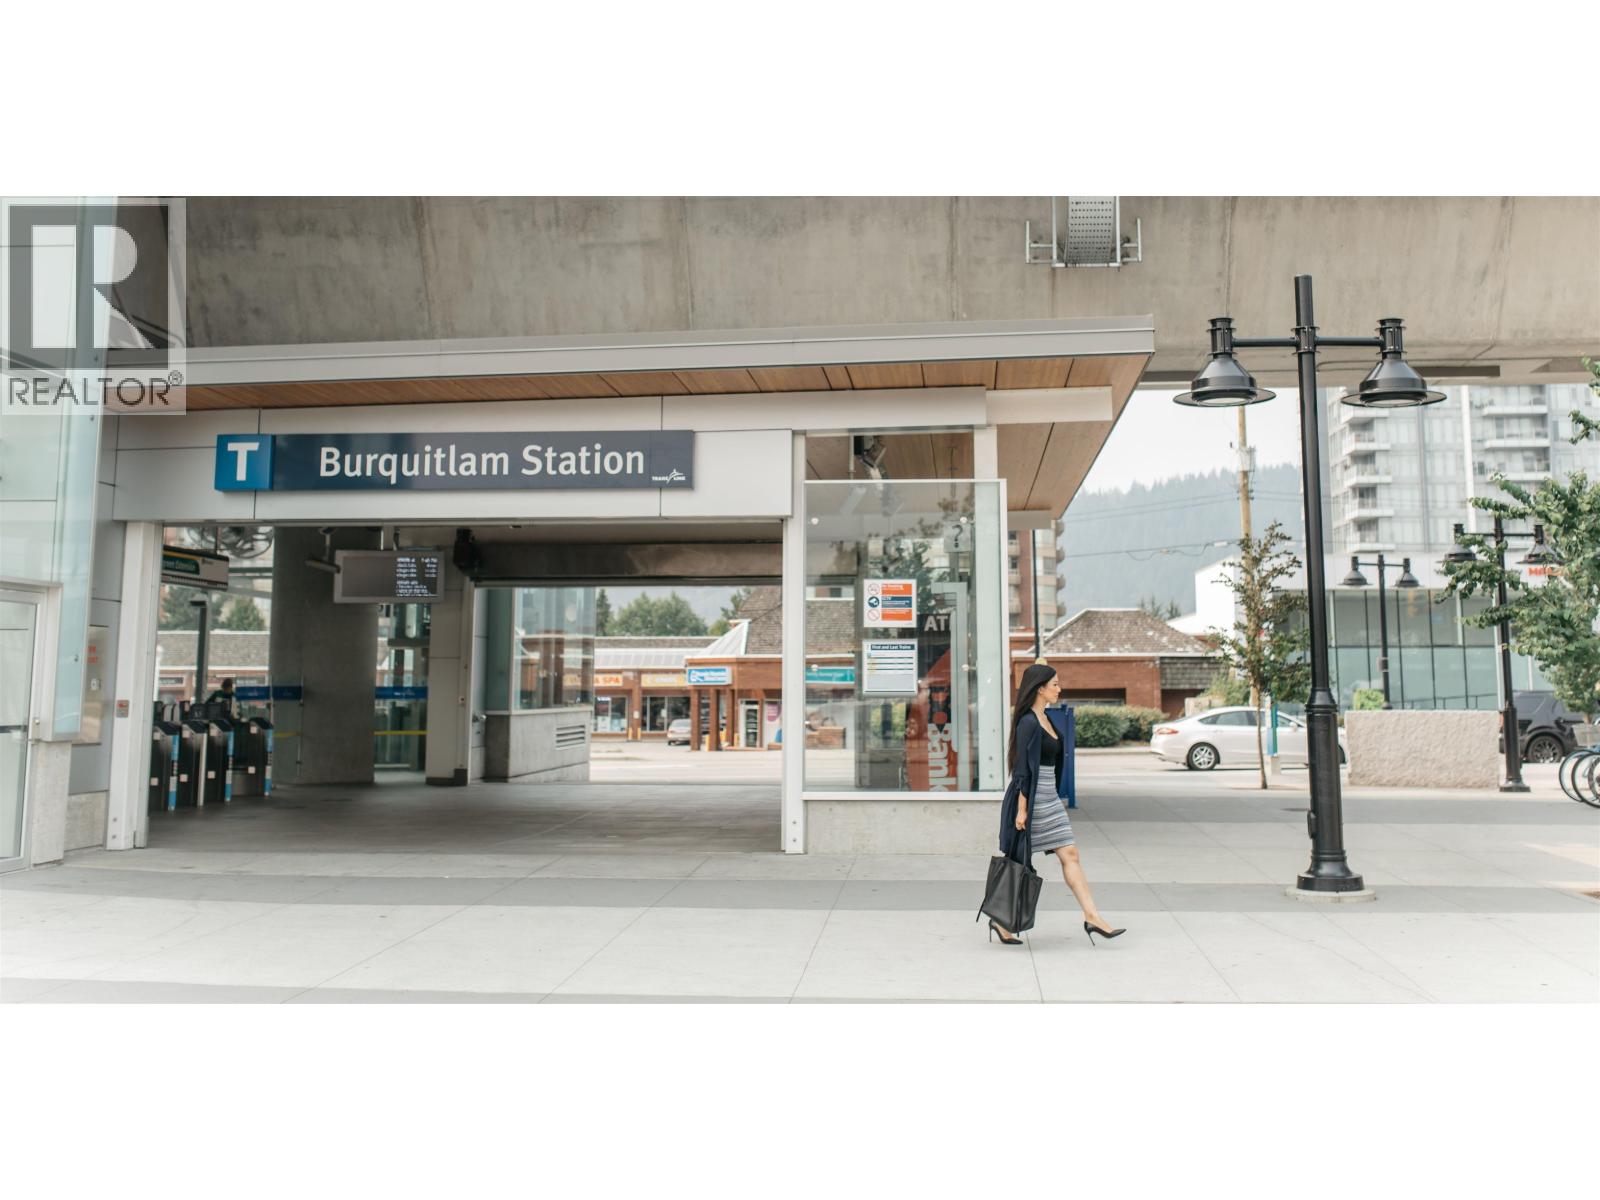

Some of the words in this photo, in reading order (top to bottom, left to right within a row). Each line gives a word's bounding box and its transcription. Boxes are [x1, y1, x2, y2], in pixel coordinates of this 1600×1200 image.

[227, 442, 260, 481] T
[319, 444, 509, 485] Burquitlam
[521, 443, 644, 476] Station
[924, 614, 952, 632] AT
